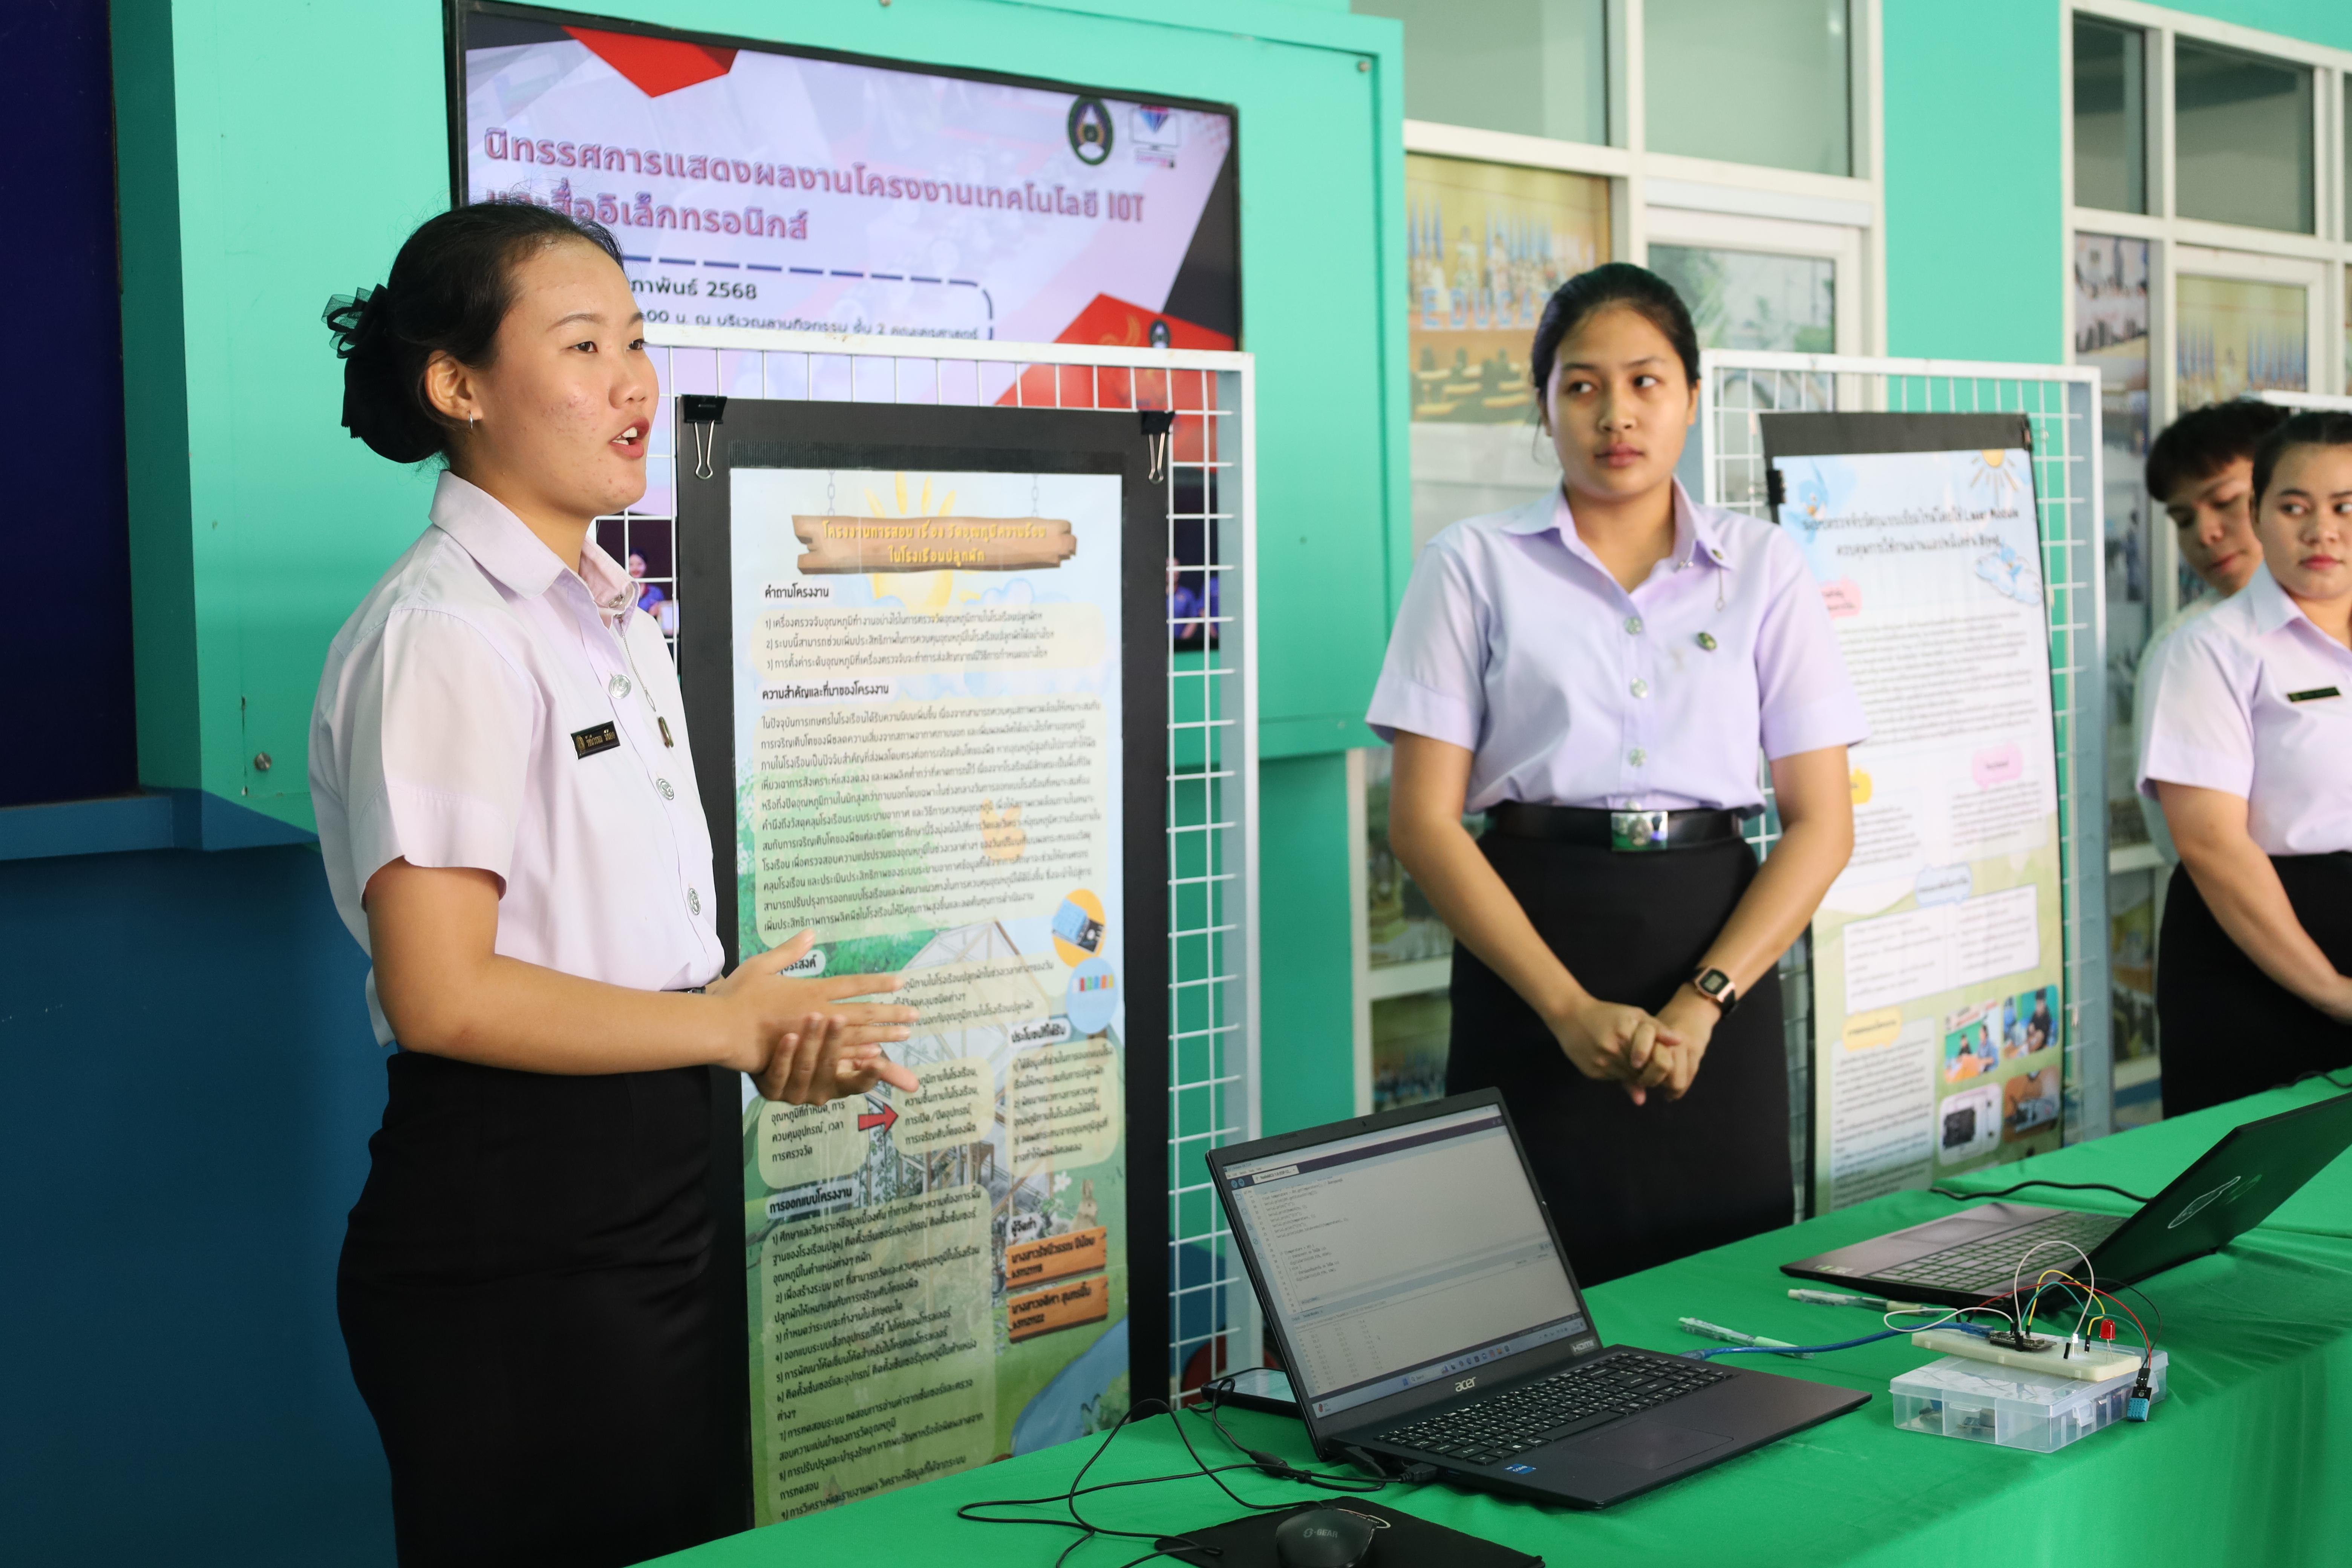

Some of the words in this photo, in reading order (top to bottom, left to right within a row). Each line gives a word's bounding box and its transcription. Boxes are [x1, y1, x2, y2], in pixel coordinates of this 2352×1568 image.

[484, 126, 1098, 218] นิทรรศการแสดงผลงานโครงงานเทคโนโลยี
[1107, 192, 1146, 223] IOT
[706, 282, 758, 300] 2568
[822, 520, 913, 539] โครงงานการสอน
[888, 545, 985, 566] ในโรงเรือนปลูกผัก
[765, 582, 829, 599] คำถามโครงงาน
[763, 681, 889, 701] ความสำคัญและที่มาของโครงงาน
[762, 858, 790, 871] โรงเรือน
[763, 876, 805, 893] คลุมโรงเรือน
[831, 1101, 845, 1110] การ
[828, 1120, 844, 1132] เวลา
[772, 1144, 813, 1163] การตรวจวัด
[770, 1187, 852, 1214] การออกแบบโครงงาน
[773, 1256, 854, 1287] อุณหภูมิในตำแหน่งต่างๆ
[784, 1283, 831, 1300] เพื่อสร้างระบบ
[1455, 1377, 1476, 1393] acer
[777, 1409, 796, 1422] ต่างๆ
[787, 1415, 845, 1438] การทดสอบระบบ
[787, 1446, 876, 1477] การปรับปรุงและบำรุงรักษา
[779, 1481, 820, 1500] การทดสอบ
